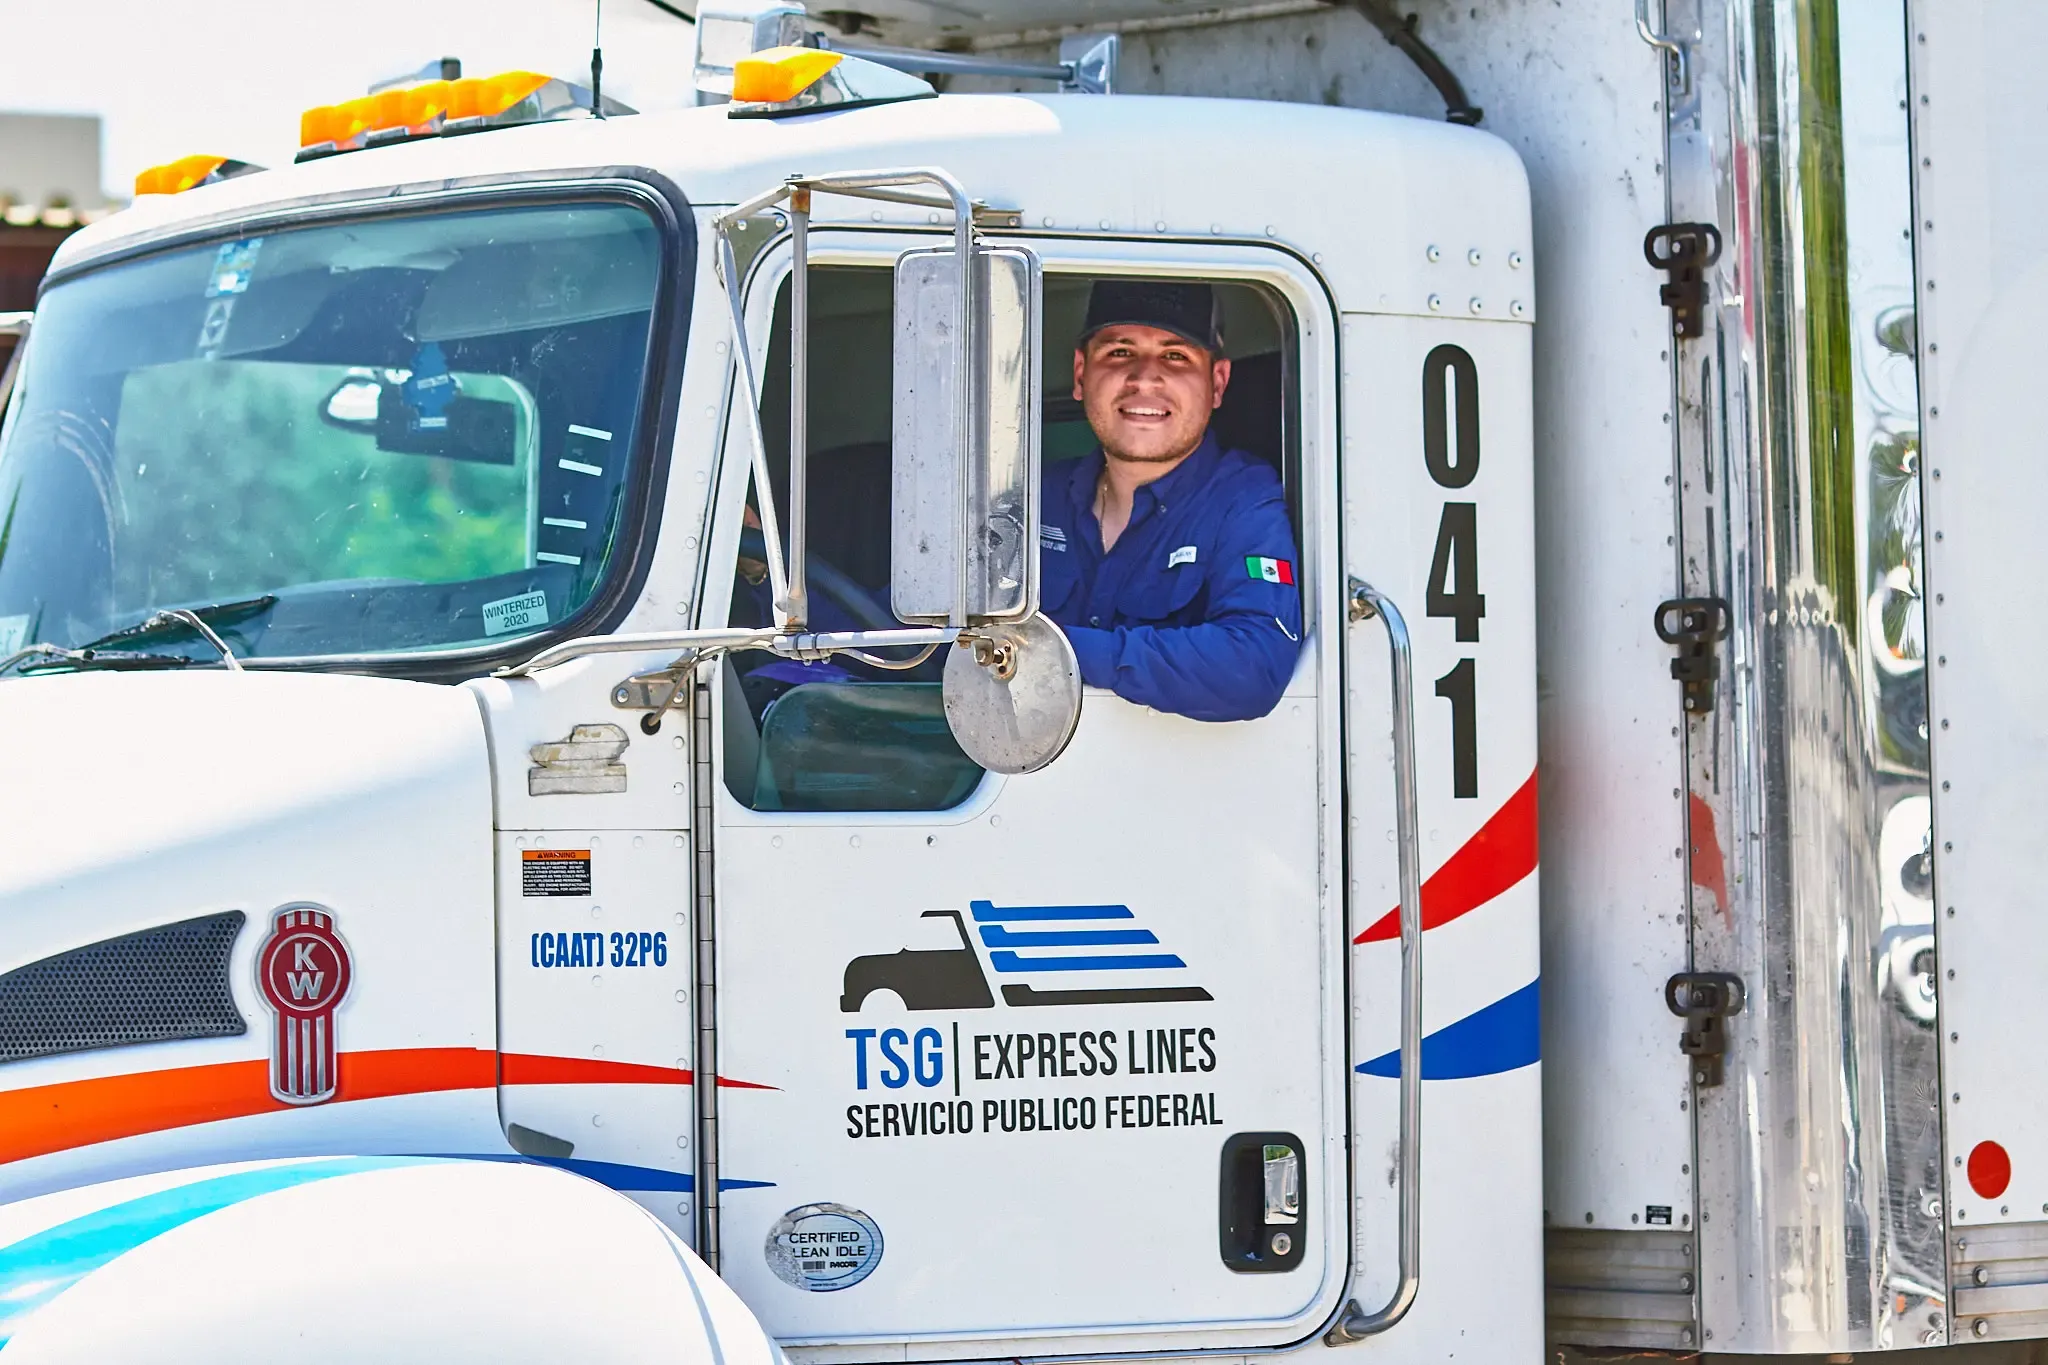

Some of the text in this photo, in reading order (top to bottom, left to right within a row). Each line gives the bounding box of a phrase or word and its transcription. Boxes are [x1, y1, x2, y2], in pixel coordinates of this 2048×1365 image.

[1422, 343, 1486, 799] 041
[484, 595, 545, 619] WINTERIZED
[503, 612, 529, 628] 2020
[531, 931, 668, 968] (CAAT) 32P6
[845, 1026, 1218, 1090] TSG EXPRESS LINES
[846, 1092, 1224, 1139] SERVICIO PUBLICO FEDERAL
[789, 1231, 860, 1244] CERTIFIED
[791, 1245, 867, 1258] LEAN IDLE
